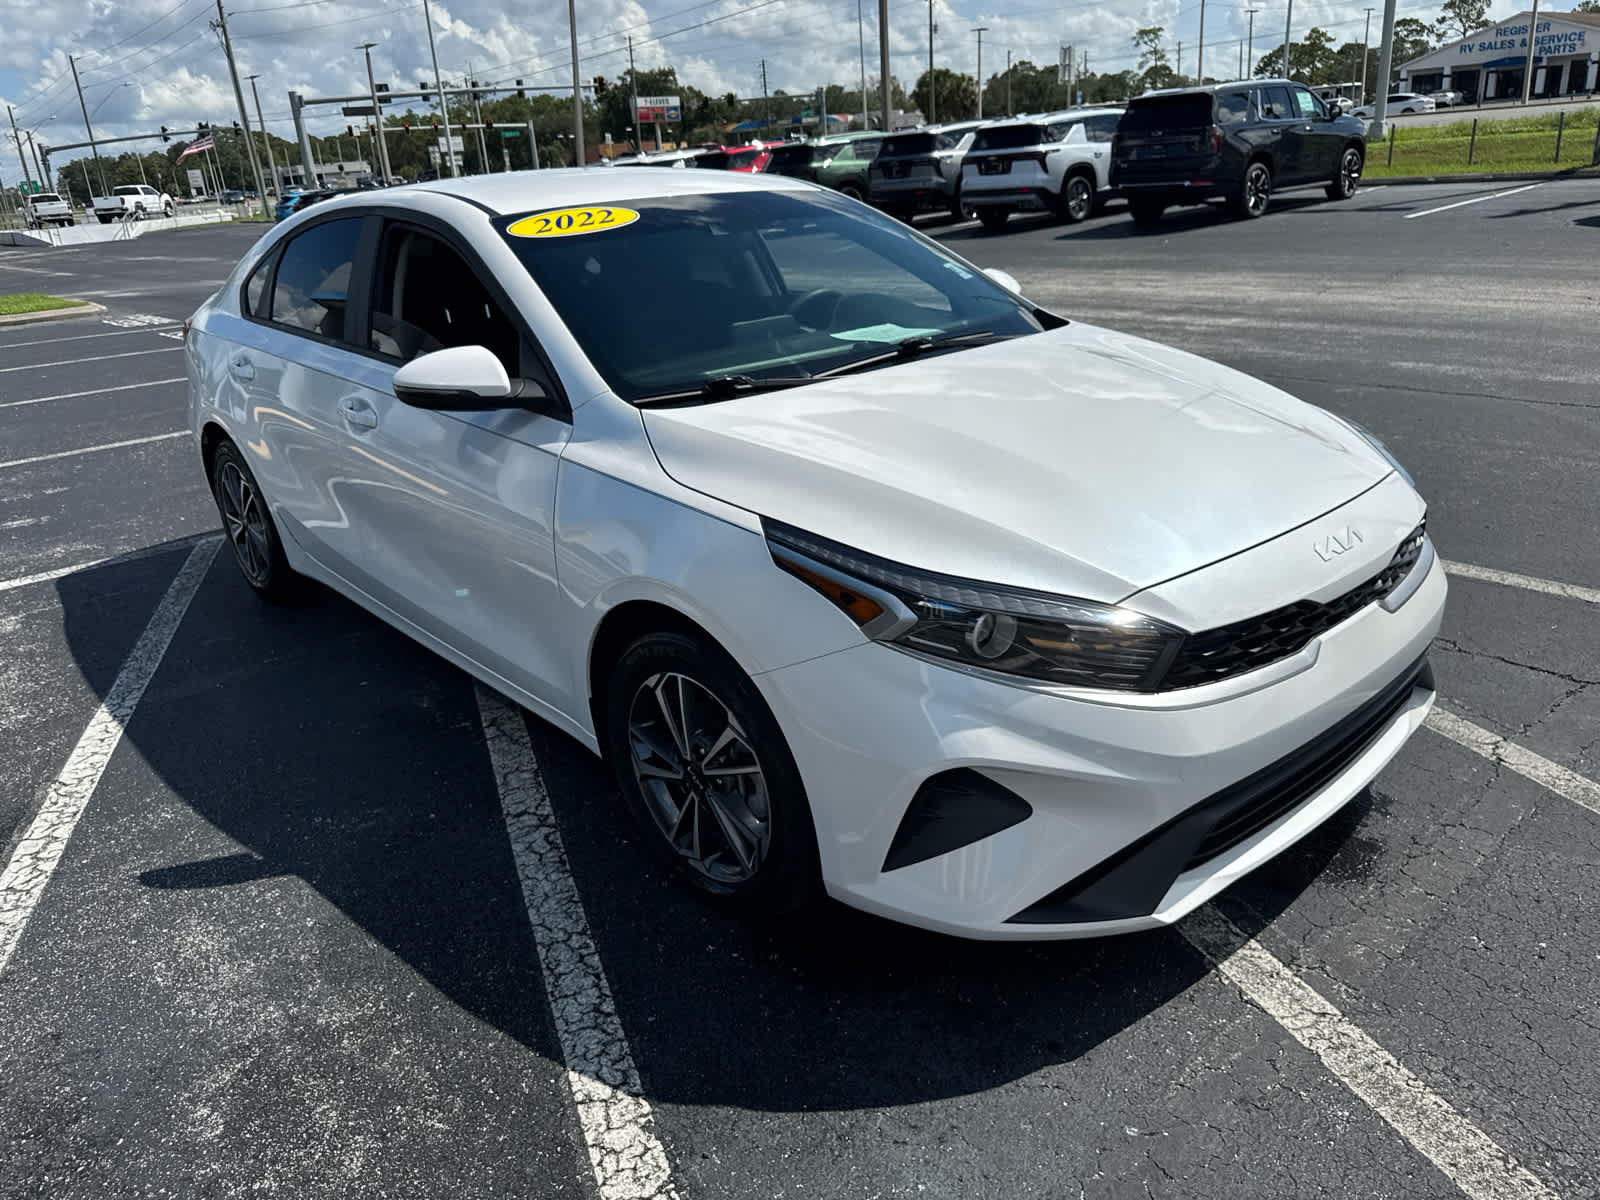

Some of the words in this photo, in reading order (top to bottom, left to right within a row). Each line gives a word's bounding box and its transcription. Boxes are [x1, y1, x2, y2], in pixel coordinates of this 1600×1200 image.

[1495, 22, 1552, 38] REGISER
[1459, 43, 1475, 55] RV
[1478, 38, 1516, 52] SALES
[1519, 38, 1528, 49] &
[1534, 30, 1586, 47] SERVICE
[1538, 42, 1577, 56] PARTS
[534, 209, 616, 235] 2022
